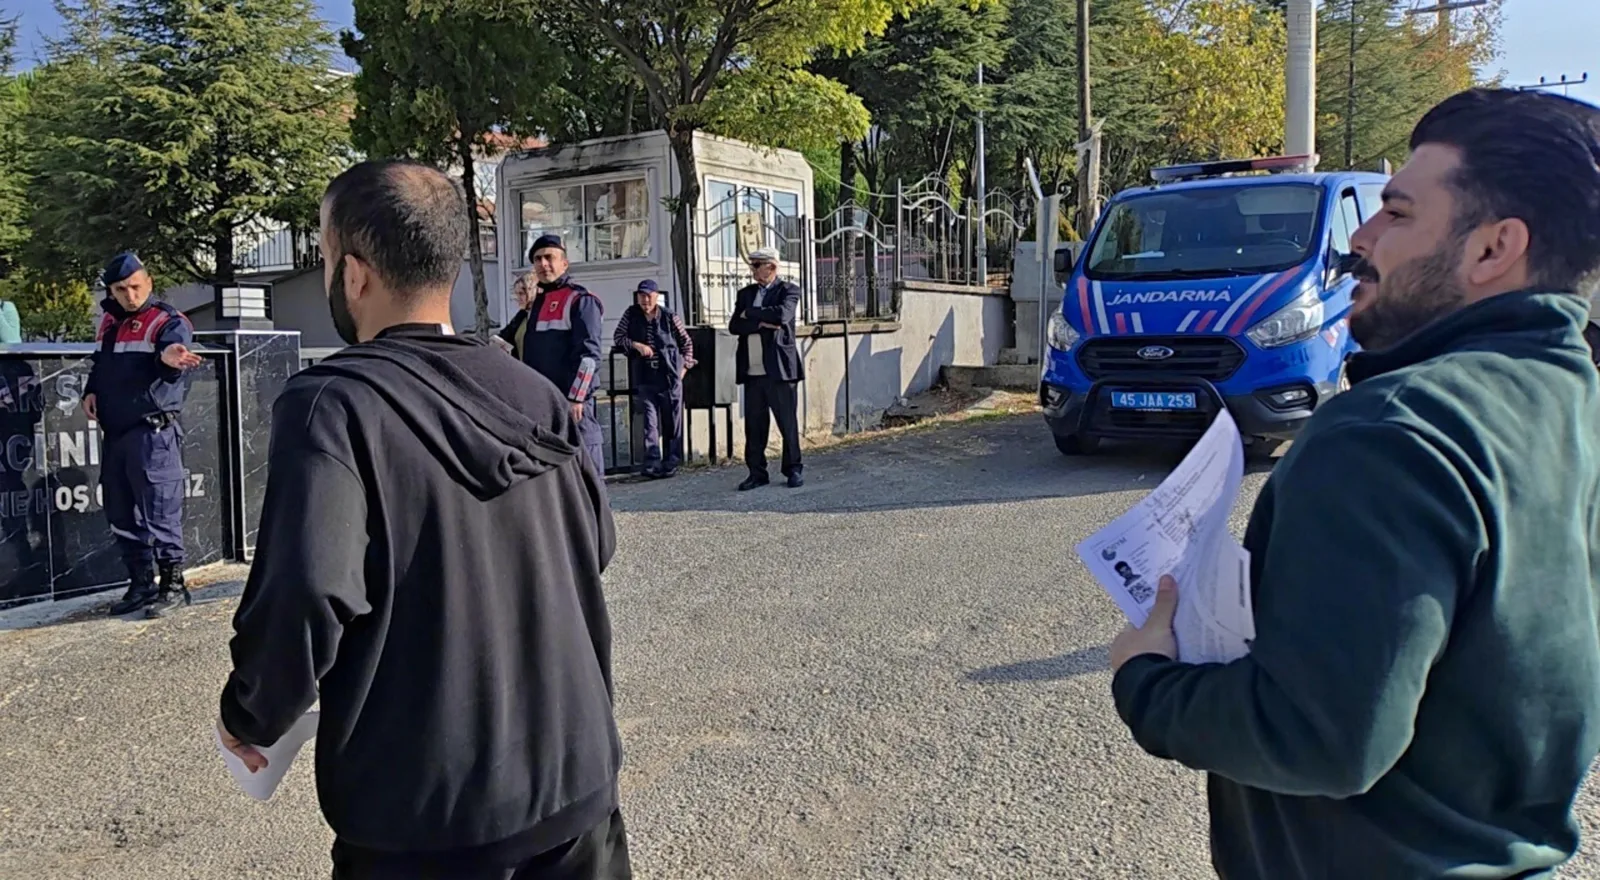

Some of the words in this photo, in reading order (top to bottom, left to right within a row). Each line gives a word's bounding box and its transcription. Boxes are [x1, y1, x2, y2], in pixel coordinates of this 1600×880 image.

[1106, 290, 1231, 305] JANDARMA
[1143, 347, 1165, 357] Ford
[1120, 394, 1136, 406] 45
[1140, 394, 1164, 407] JAA
[1168, 394, 1192, 407] 253
[36, 484, 89, 513] HOŞ
